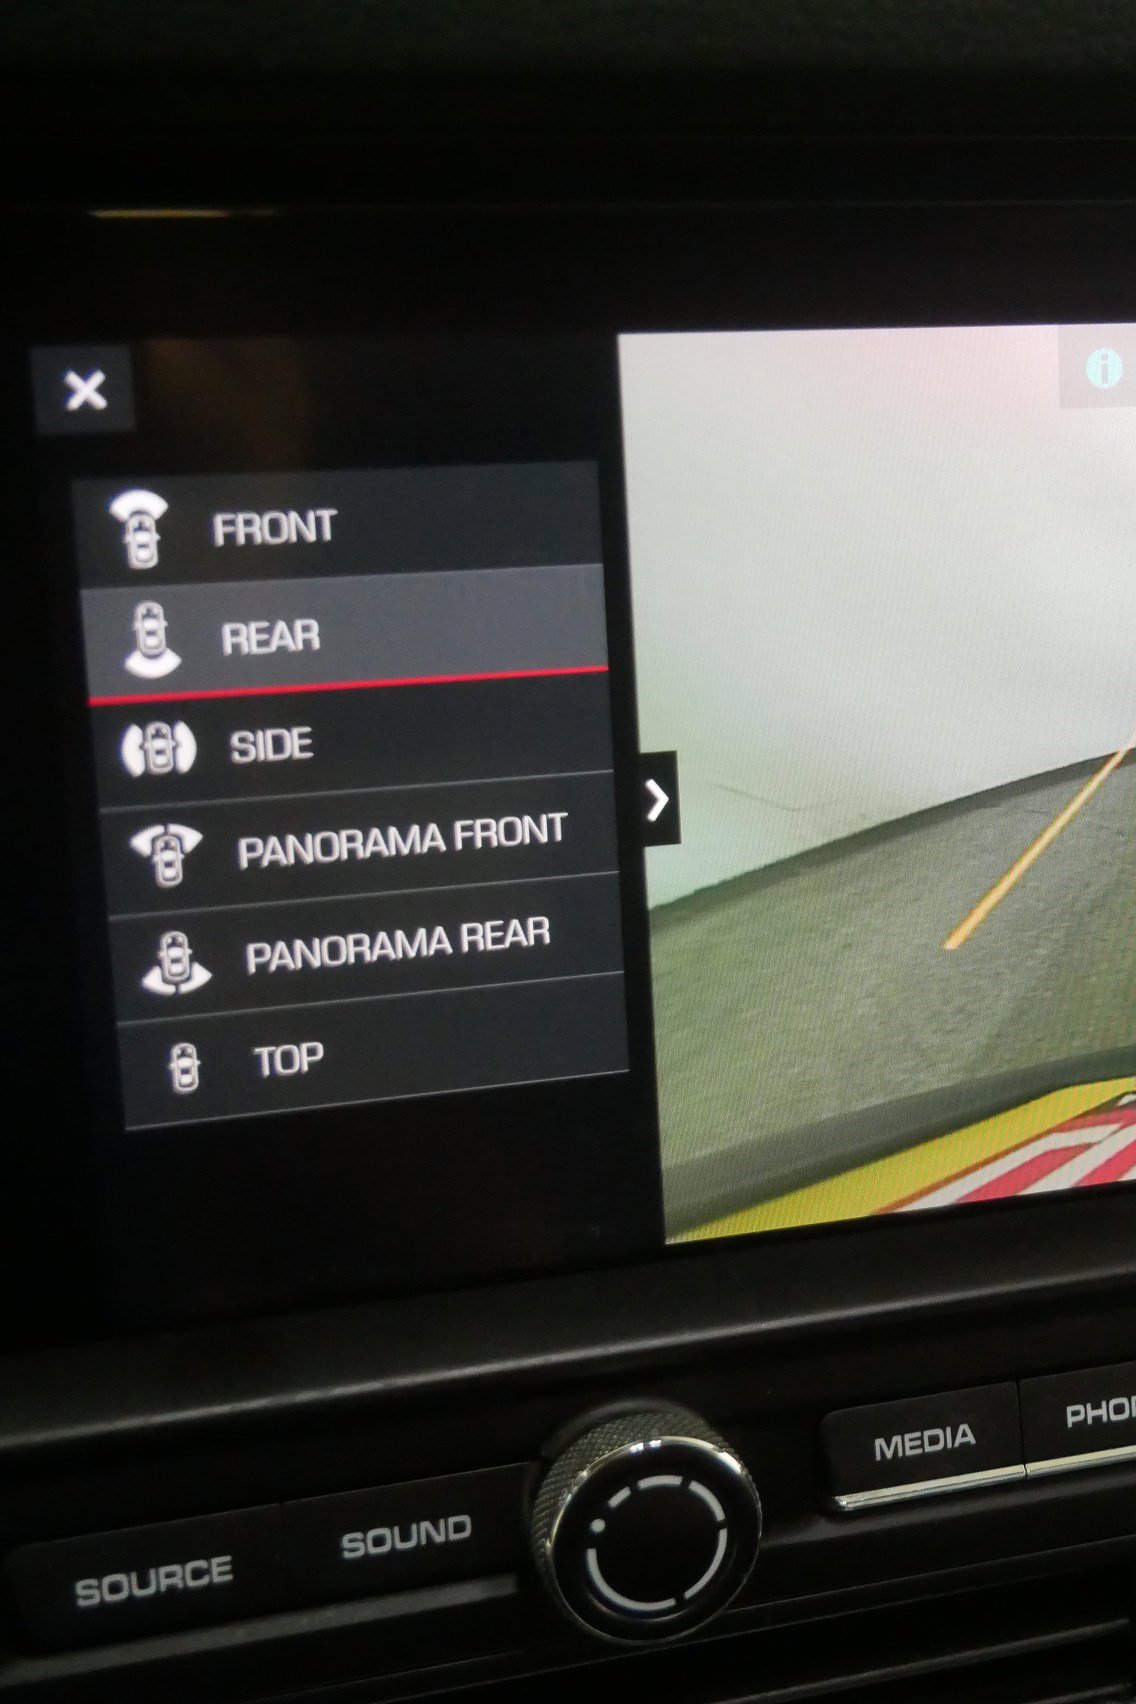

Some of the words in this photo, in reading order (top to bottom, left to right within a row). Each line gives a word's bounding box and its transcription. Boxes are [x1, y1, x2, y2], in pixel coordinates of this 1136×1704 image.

[212, 508, 338, 546] FRONT
[221, 618, 321, 657] REAR
[229, 726, 314, 764] SIDE
[238, 823, 446, 870] PANORAMA
[453, 811, 569, 850] FRONT
[245, 926, 452, 975] PANORAMA
[460, 916, 551, 952] REAR
[253, 1041, 324, 1078] TOP
[874, 1423, 977, 1461] MEDIA
[341, 1514, 472, 1559] SOUND
[75, 1556, 234, 1607] SOURCE
